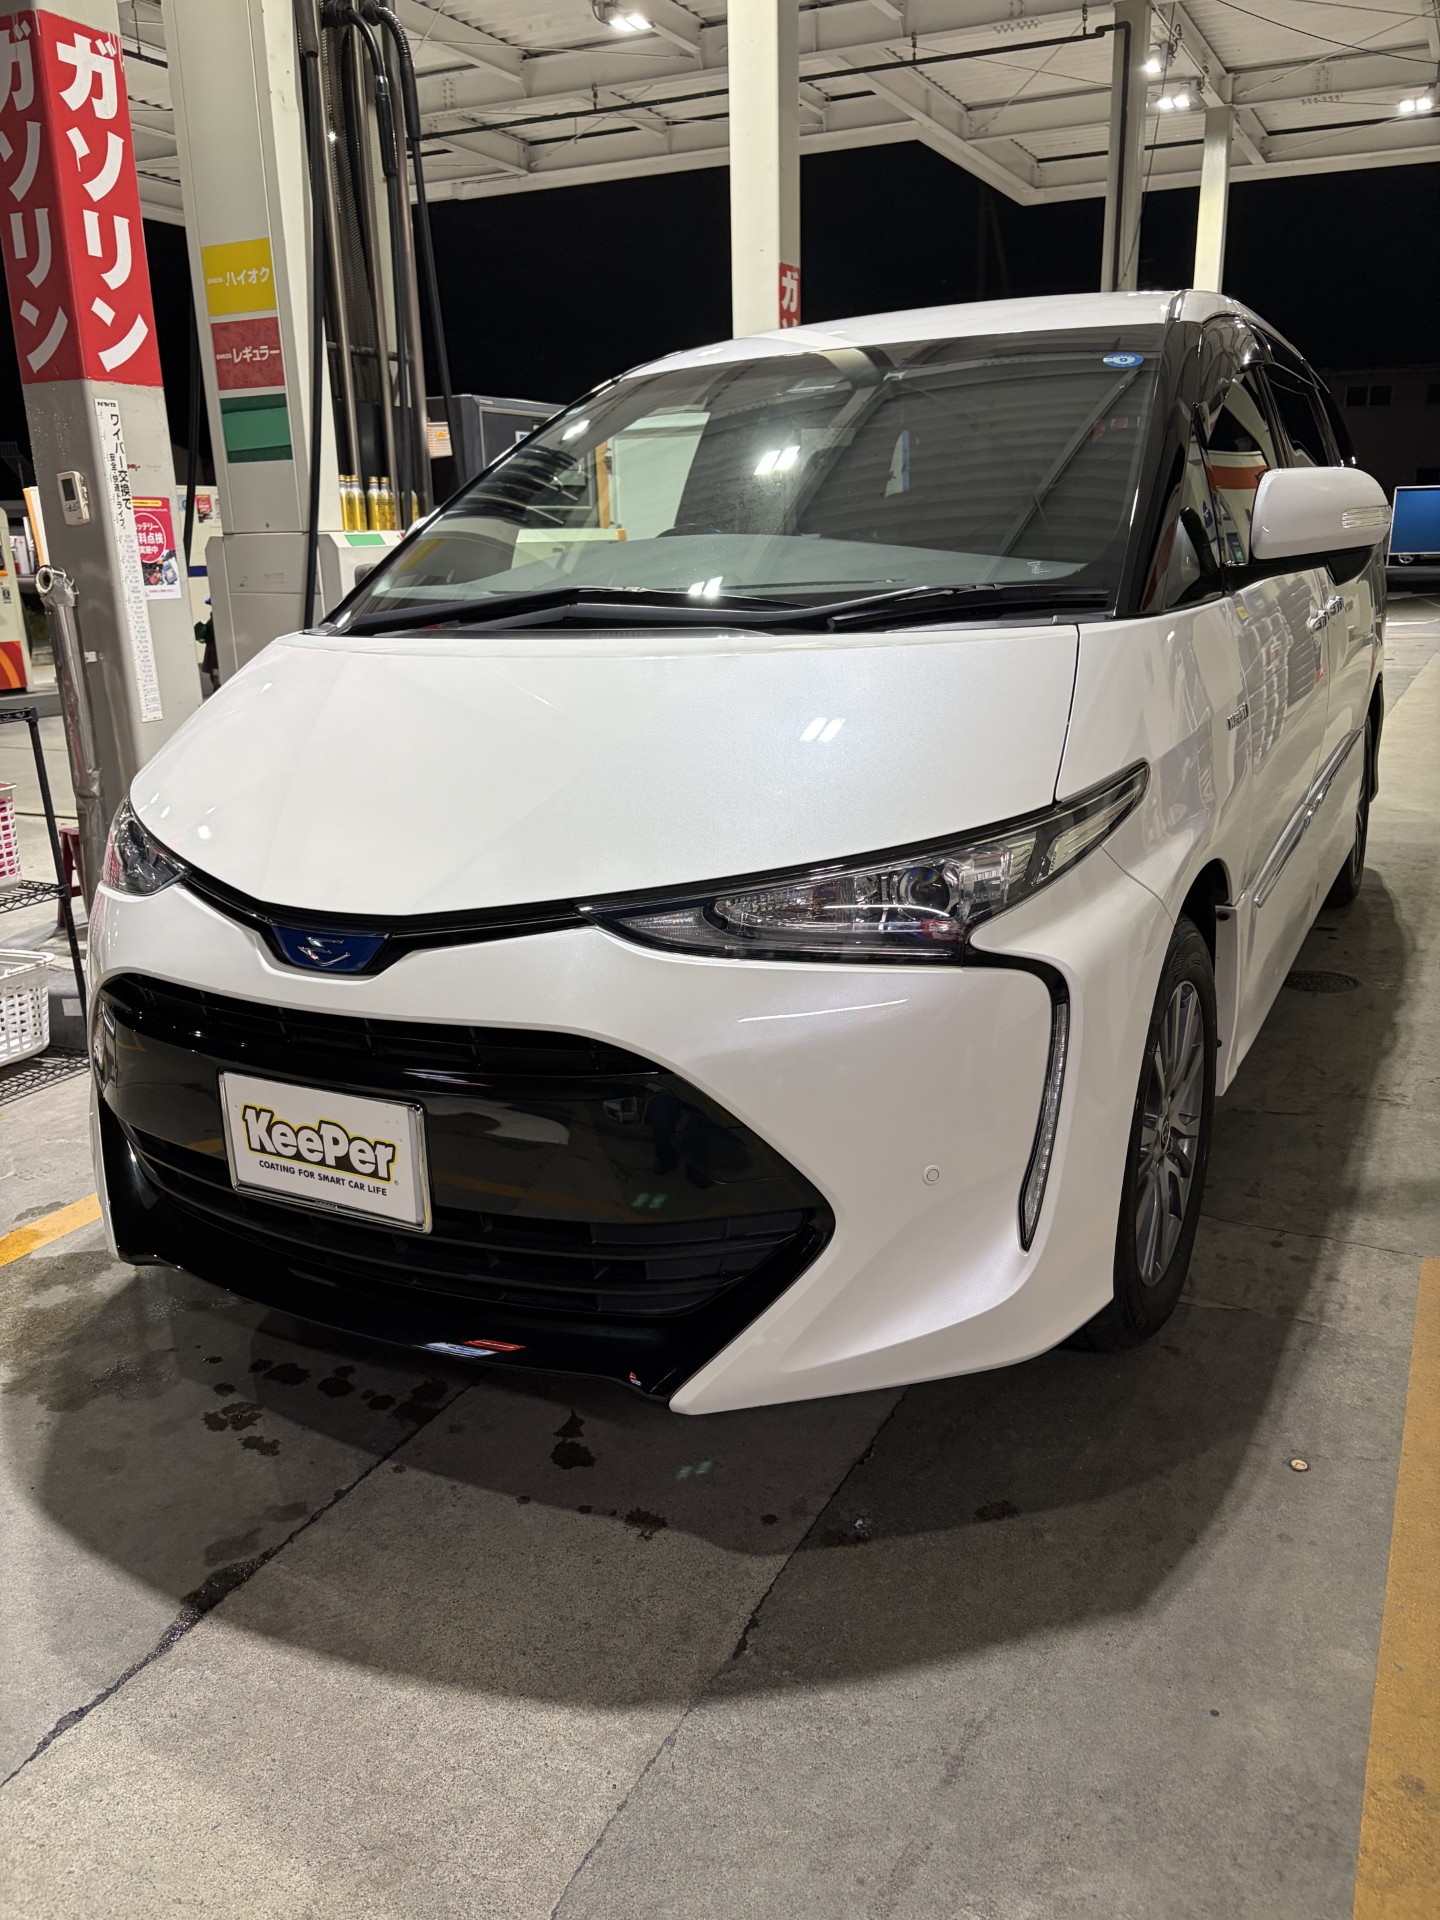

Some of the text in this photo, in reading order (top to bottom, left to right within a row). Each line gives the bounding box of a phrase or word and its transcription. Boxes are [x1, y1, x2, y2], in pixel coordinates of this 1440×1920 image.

[0, 20, 69, 374] ガソリン
[56, 32, 149, 373] ガソリン
[225, 267, 270, 286] ハイオク
[781, 270, 799, 329] ガ
[232, 345, 280, 364] レギュラー
[110, 413, 132, 510] ワイパー交換で
[136, 522, 159, 531] ッテリー
[137, 532, 164, 545] 料点検
[242, 1104, 396, 1182] KeePer
[259, 1159, 388, 1197] COATING FOR SMART CAR LIFE
